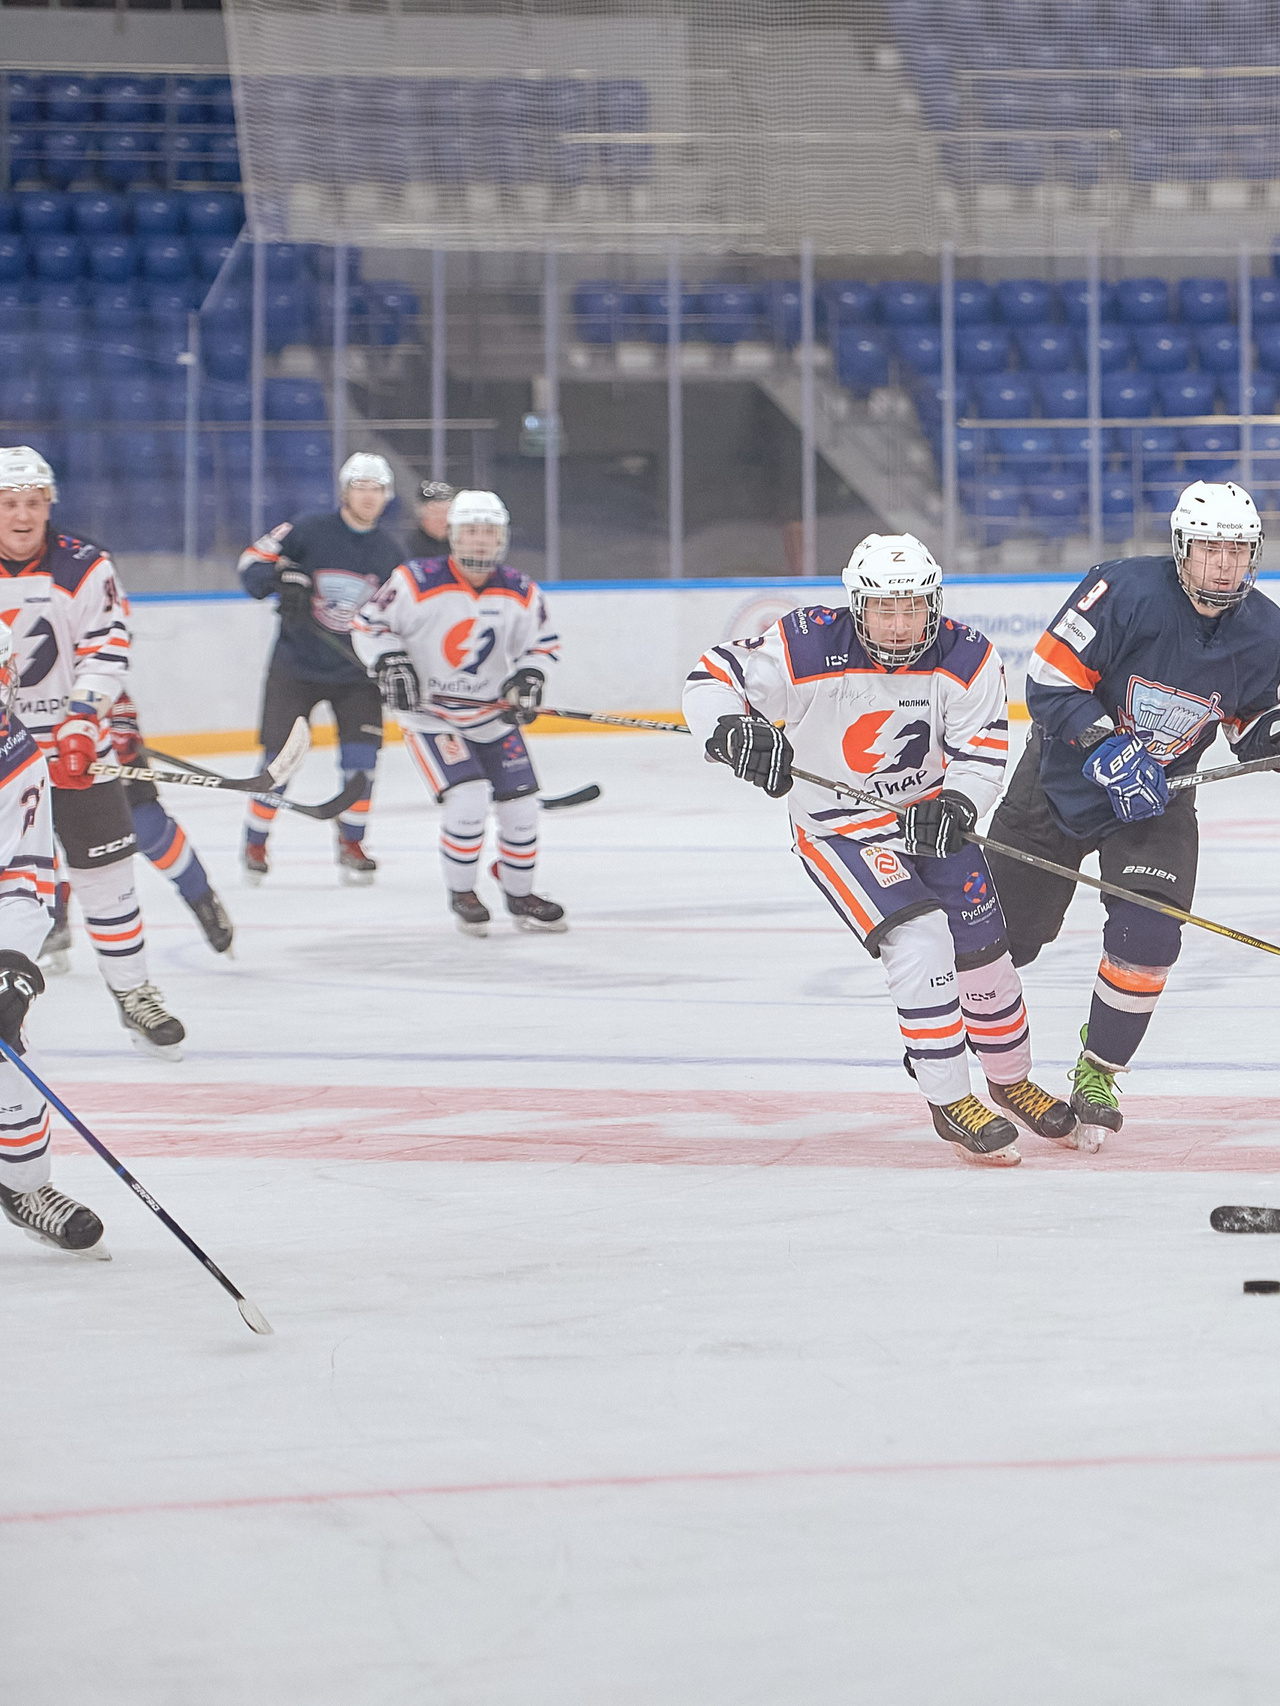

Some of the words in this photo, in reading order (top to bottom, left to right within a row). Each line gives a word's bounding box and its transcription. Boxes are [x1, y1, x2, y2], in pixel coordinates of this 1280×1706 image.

[1216, 522, 1244, 530] Reebok
[890, 551, 906, 562] Z
[1077, 578, 1109, 612] 9
[87, 832, 137, 858] CCM
[882, 871, 909, 887] НПХЛ
[1122, 865, 1177, 883] BAUER
[961, 896, 996, 921] РусГидро
